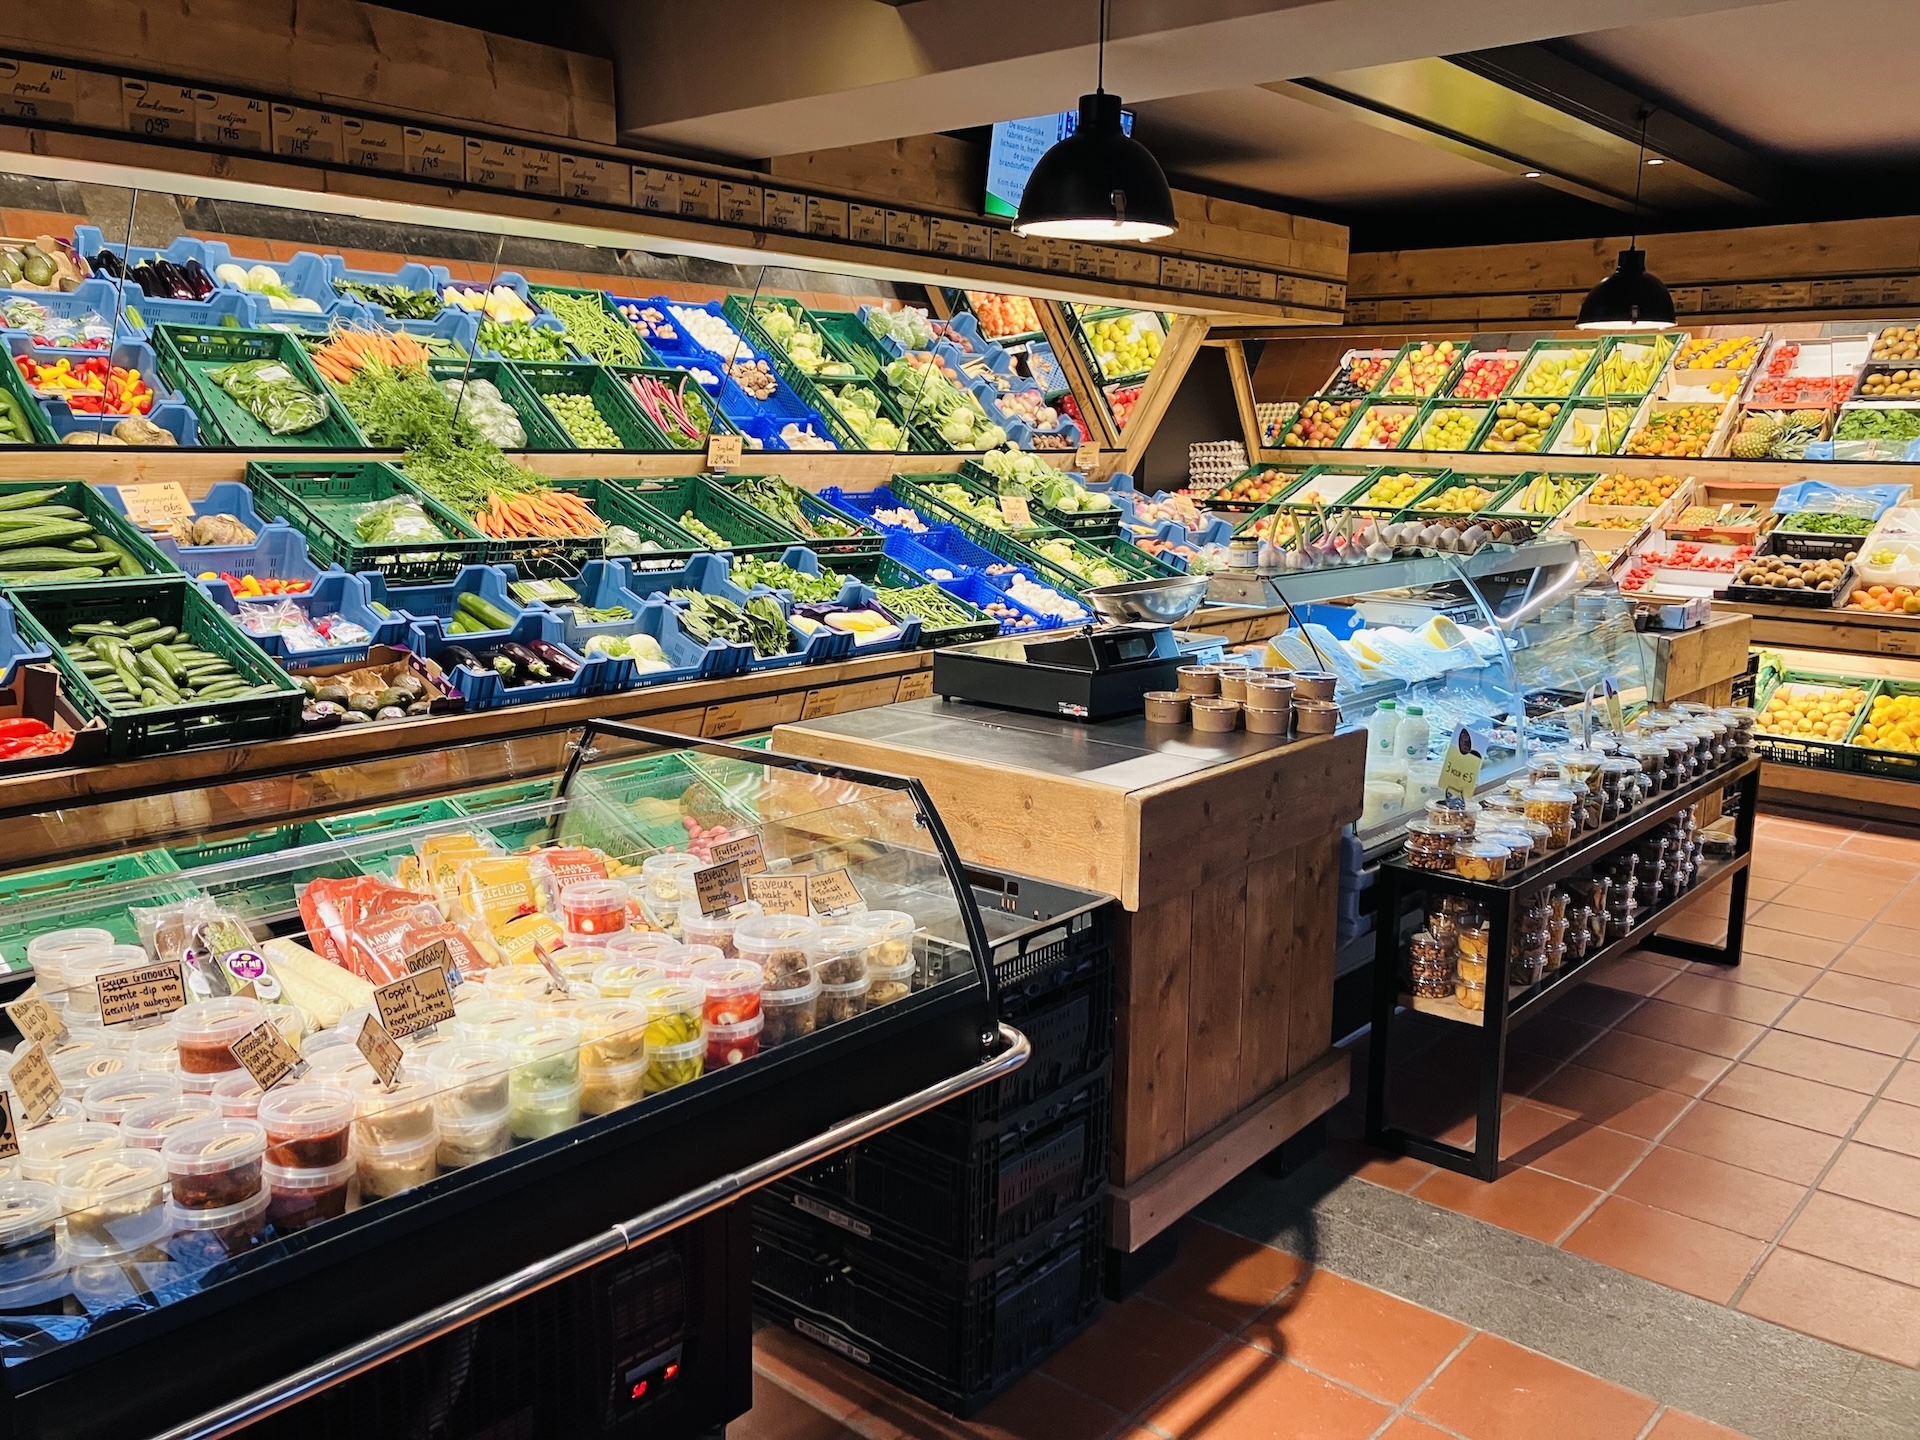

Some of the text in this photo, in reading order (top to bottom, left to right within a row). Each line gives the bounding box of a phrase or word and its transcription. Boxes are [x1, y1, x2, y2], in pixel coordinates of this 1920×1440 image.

[51, 70, 66, 81] NL
[1007, 130, 1024, 141] fabriek
[230, 958, 262, 969] EAT ME
